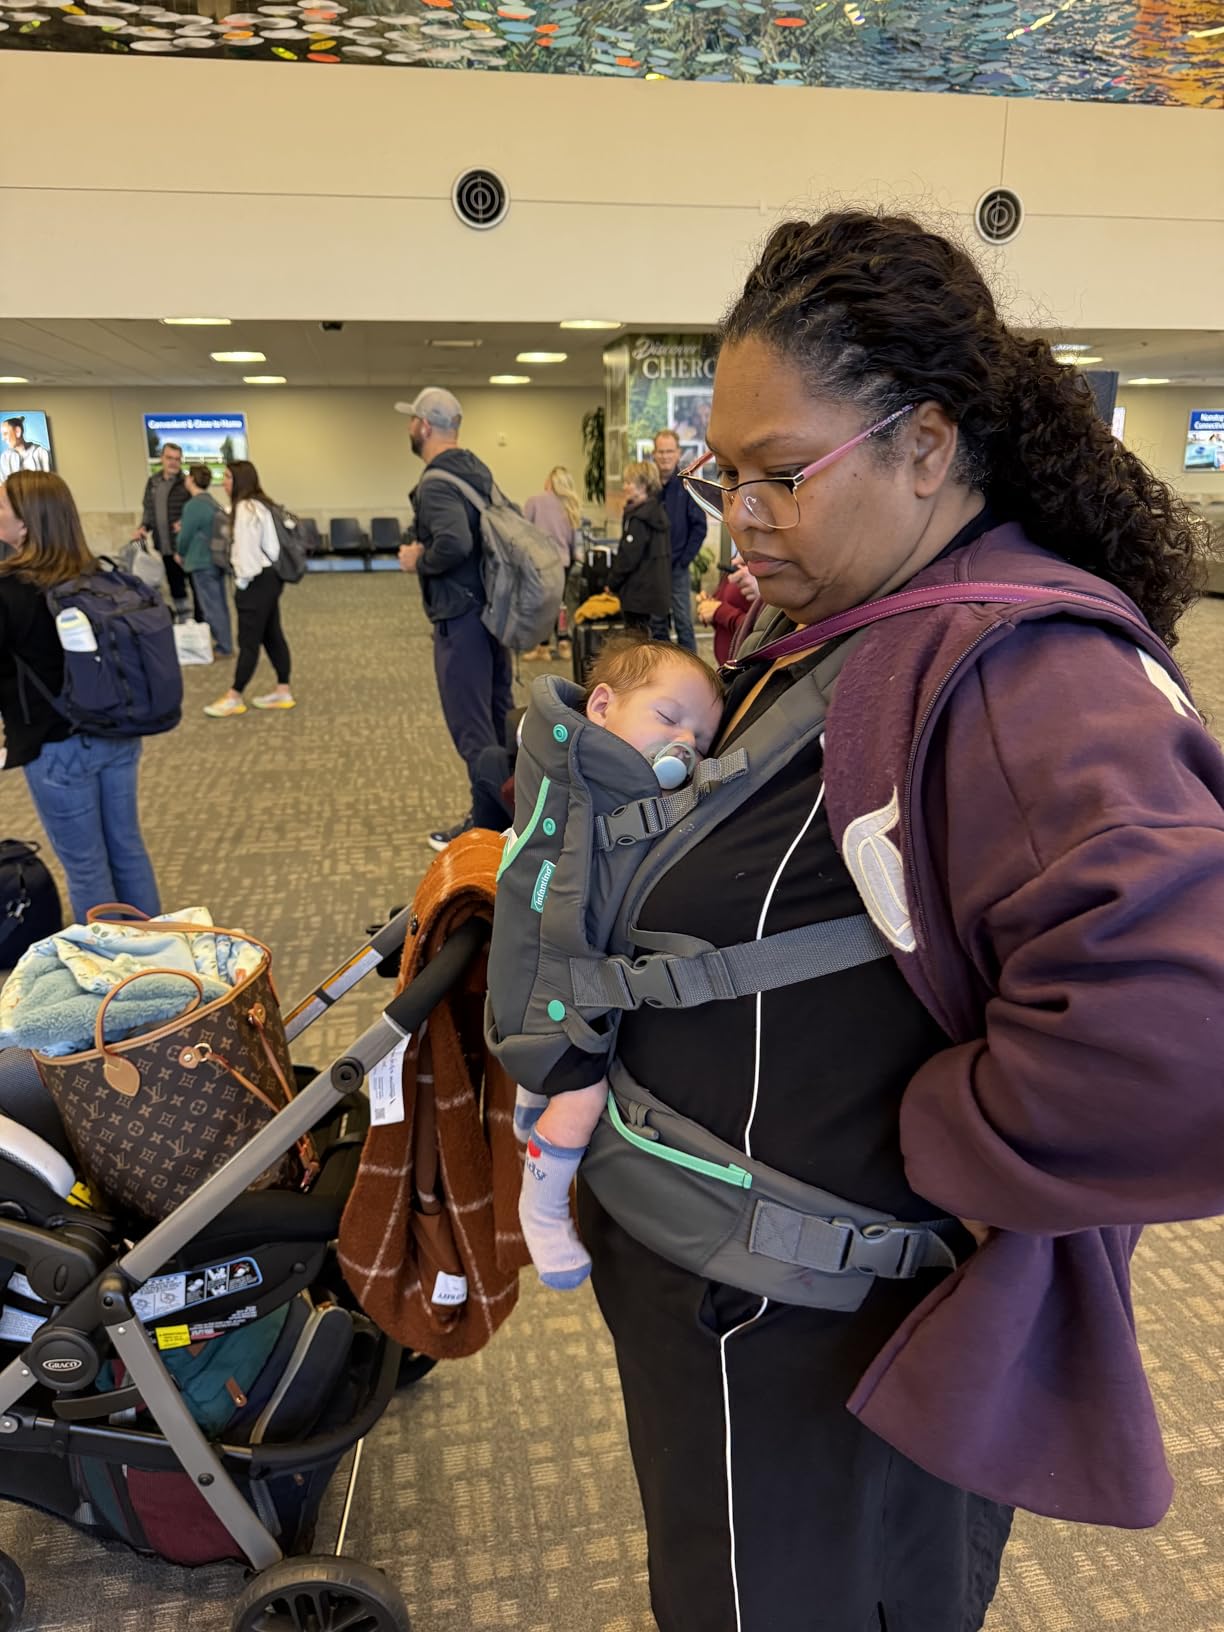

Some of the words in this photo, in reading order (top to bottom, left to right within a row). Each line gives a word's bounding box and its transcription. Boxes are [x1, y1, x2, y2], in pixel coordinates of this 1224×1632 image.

[632, 337, 698, 360] Discover
[535, 867, 552, 906] infantino
[47, 1361, 77, 1369] GRACO
